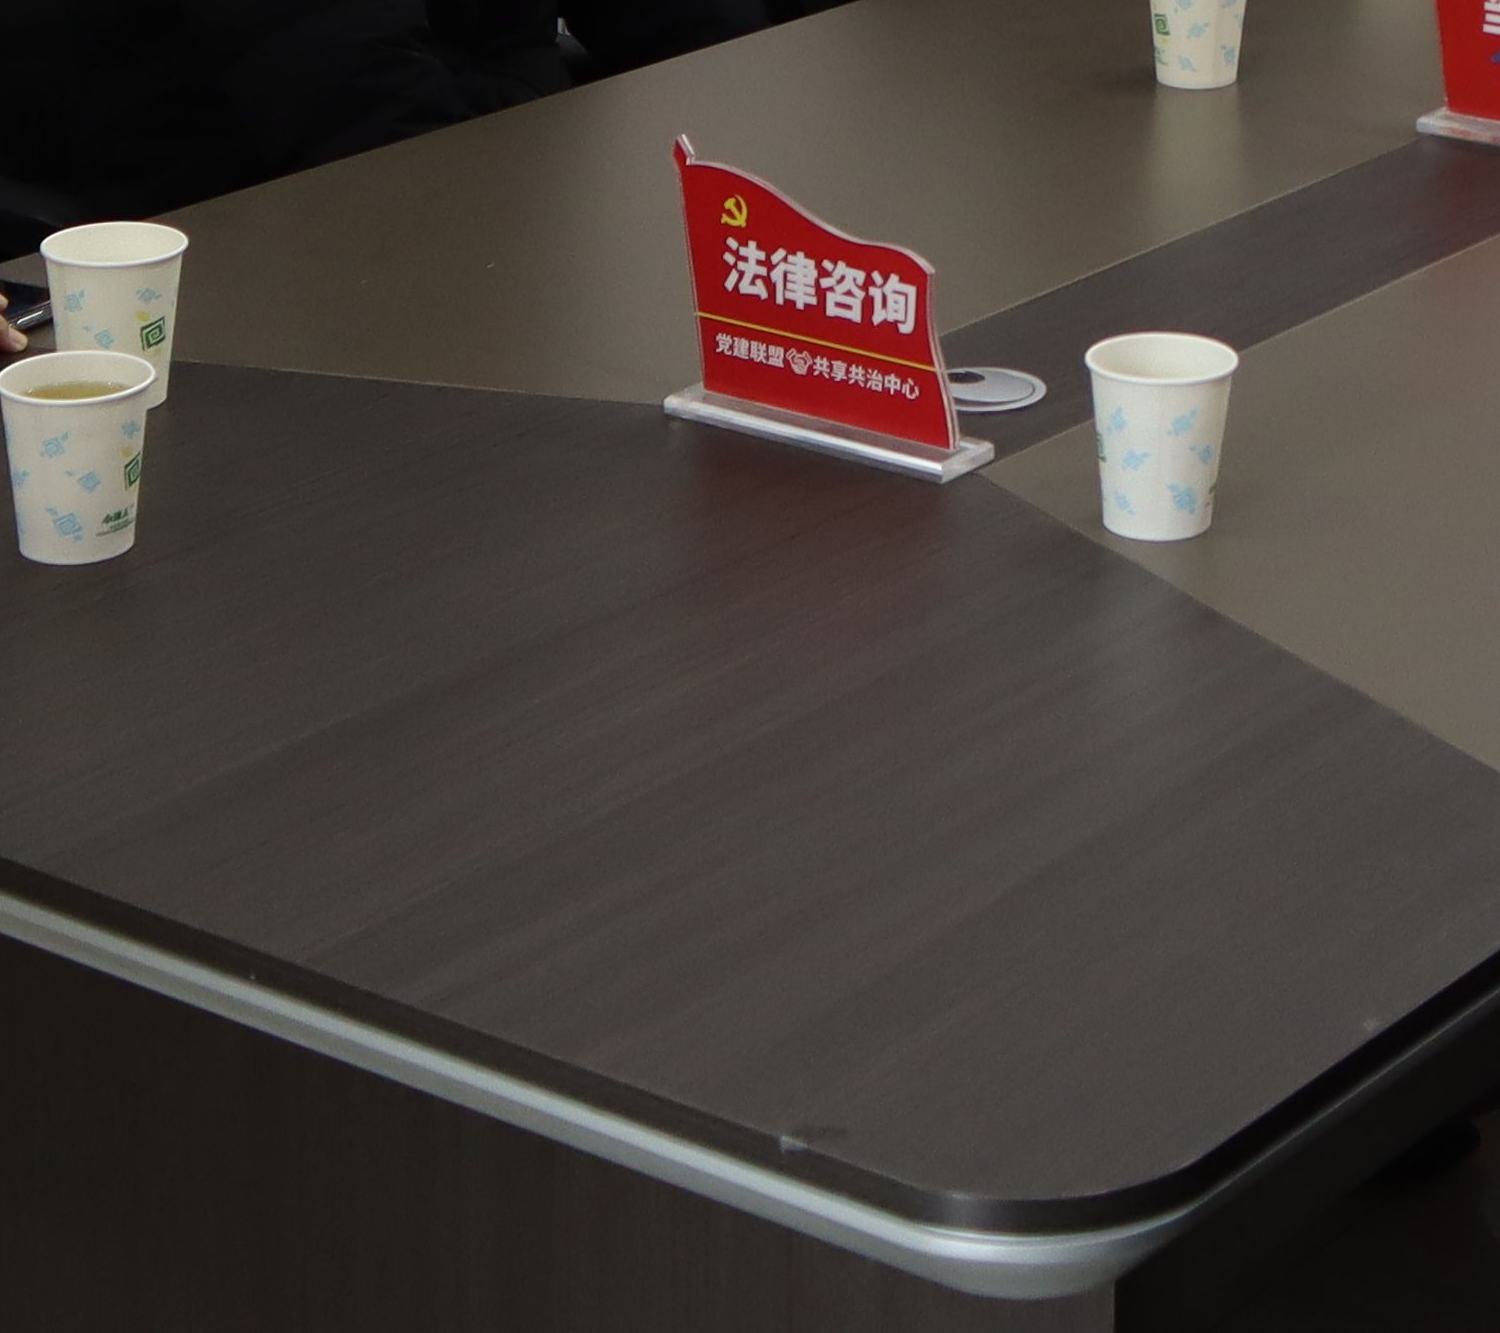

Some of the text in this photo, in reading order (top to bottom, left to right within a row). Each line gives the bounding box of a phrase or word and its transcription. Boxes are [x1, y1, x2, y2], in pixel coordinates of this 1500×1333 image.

[722, 237, 918, 335] 法律咨询
[715, 332, 920, 400] 党建联盟 共享共治中心
